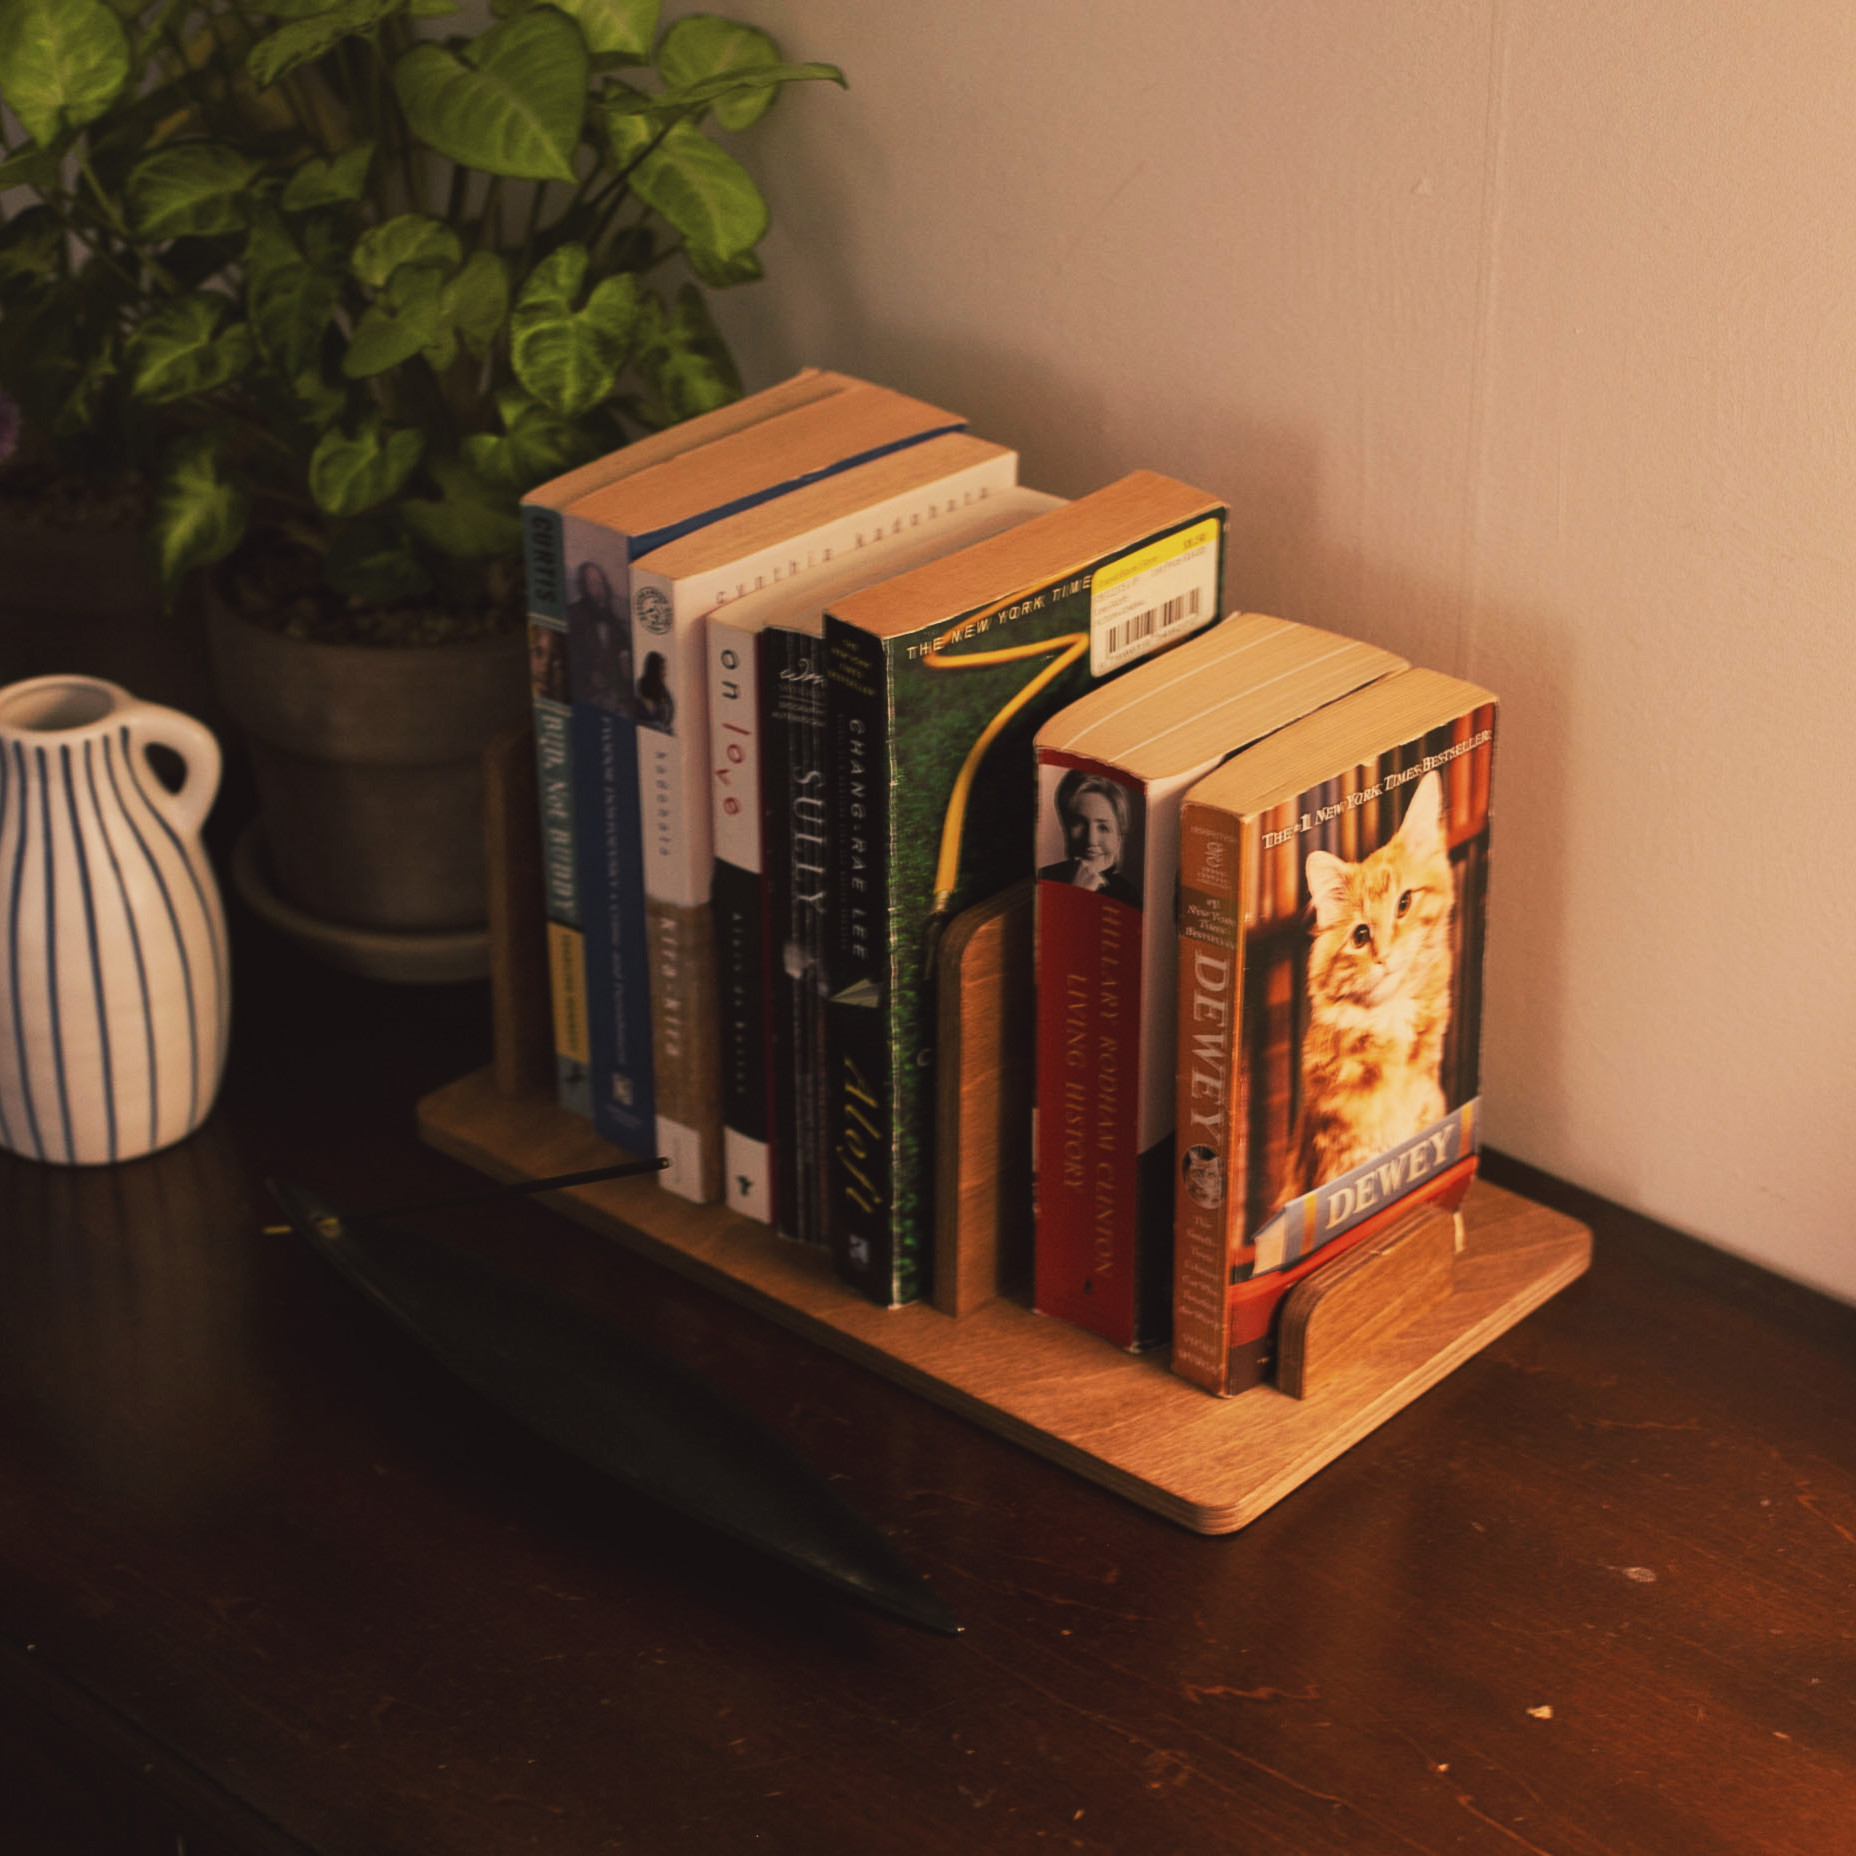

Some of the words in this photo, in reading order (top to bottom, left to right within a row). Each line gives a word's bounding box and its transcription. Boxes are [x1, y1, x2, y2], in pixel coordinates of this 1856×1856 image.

[531, 515, 556, 602] CURTIS
[906, 635, 944, 660] THE
[950, 619, 990, 645] NEW
[997, 594, 1046, 624] YORK
[1051, 573, 1093, 603] TIME
[720, 649, 740, 700] on
[547, 780, 569, 819] Not
[714, 723, 752, 816] love
[849, 718, 868, 893] CHANG-RAE
[1261, 828, 1293, 850] THE
[1314, 805, 1344, 826] NEW
[1345, 783, 1382, 810] YORK
[1383, 766, 1421, 792] TIMES
[1420, 729, 1493, 773] BESTSELLER
[549, 829, 575, 916] BUDDY
[792, 764, 828, 915] SULLY
[851, 907, 870, 961] LEE
[1098, 905, 1121, 1027] HILLARY
[1065, 973, 1088, 1069] LIVING
[1190, 947, 1231, 1147] DEWEY
[836, 1055, 884, 1214] Aloft
[1063, 1081, 1087, 1194] HISTORY
[1096, 1034, 1120, 1153] RODHAM
[1094, 1162, 1117, 1280] CLINTON
[1324, 1123, 1457, 1231] DEWEY
